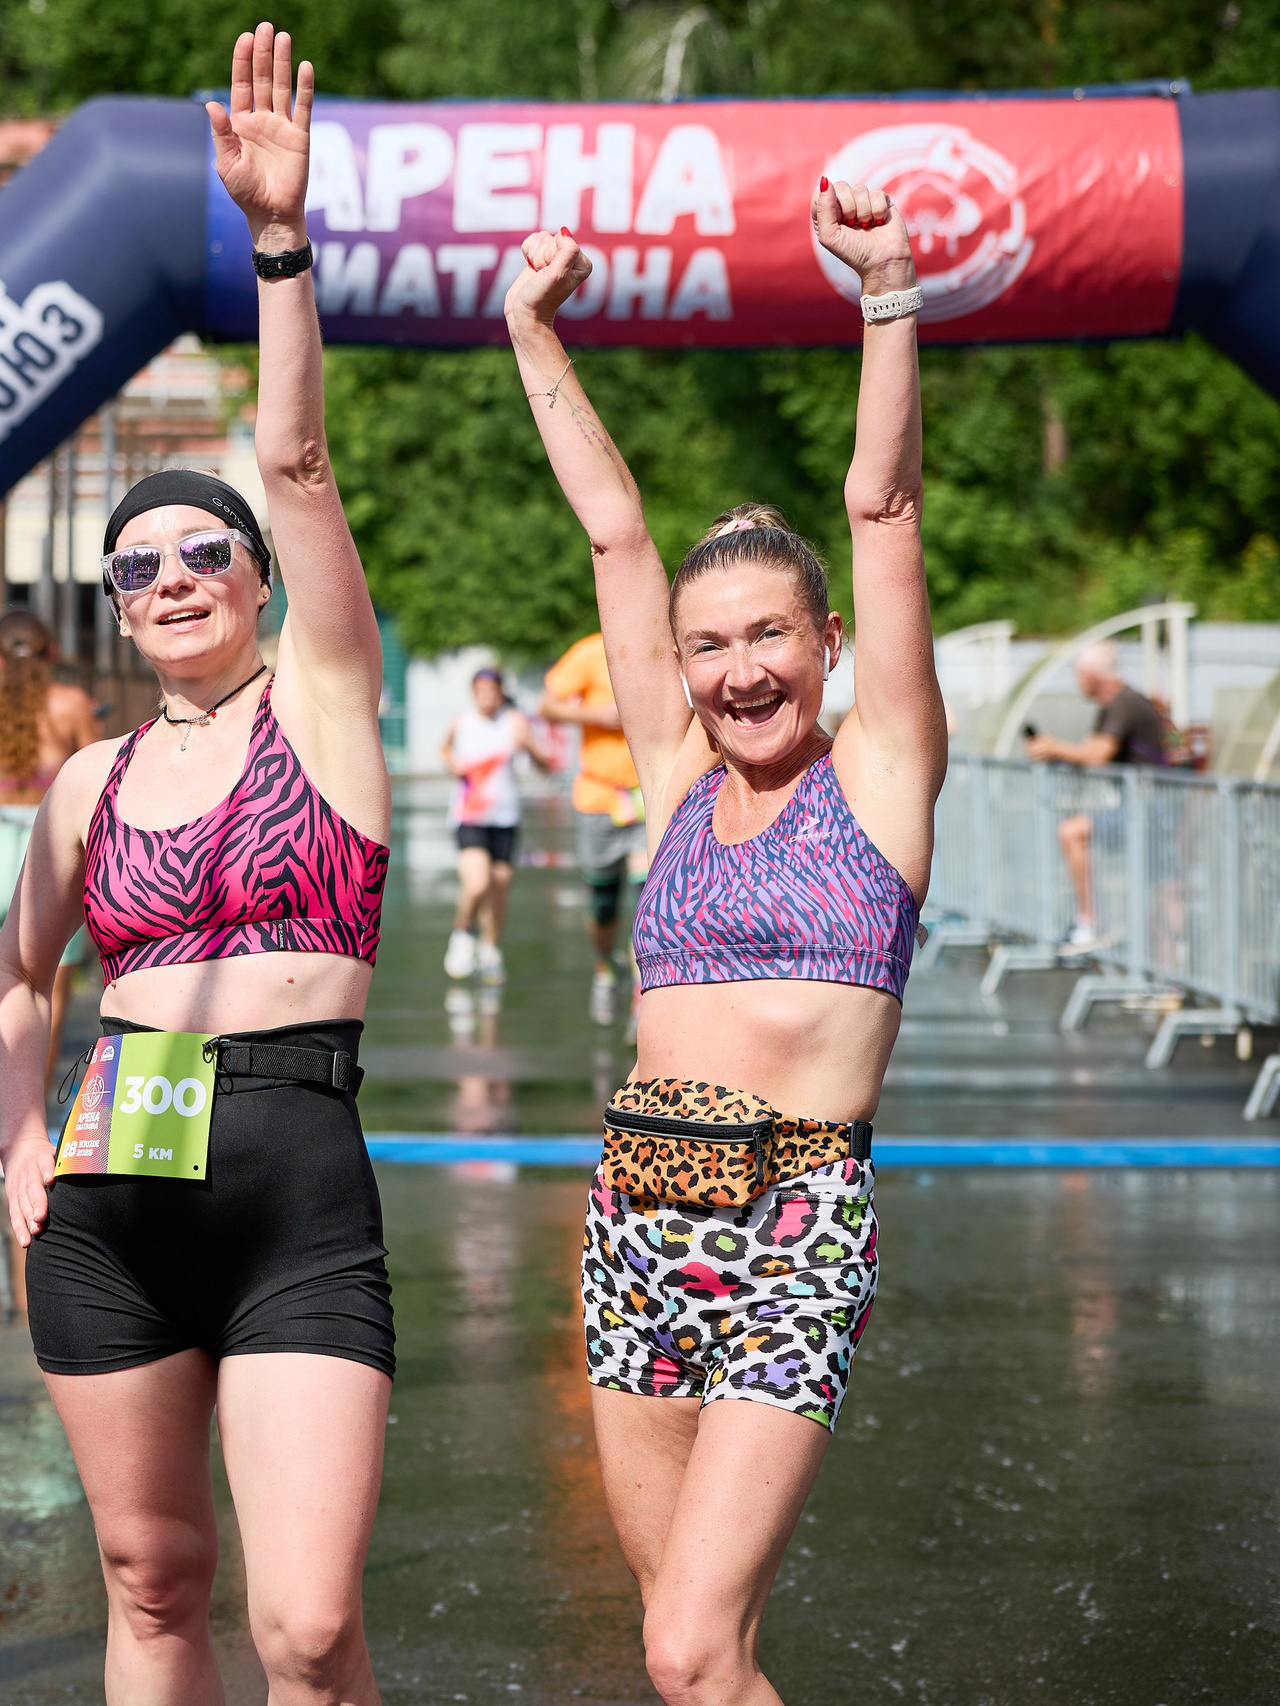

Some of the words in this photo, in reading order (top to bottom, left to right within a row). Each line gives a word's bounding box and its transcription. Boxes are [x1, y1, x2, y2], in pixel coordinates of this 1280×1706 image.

[306, 120, 736, 237] АРЕНА
[312, 240, 734, 322] ИАТОНА
[120, 1075, 207, 1118] 300
[62, 1140, 78, 1159] 28
[132, 1143, 144, 1159] 5
